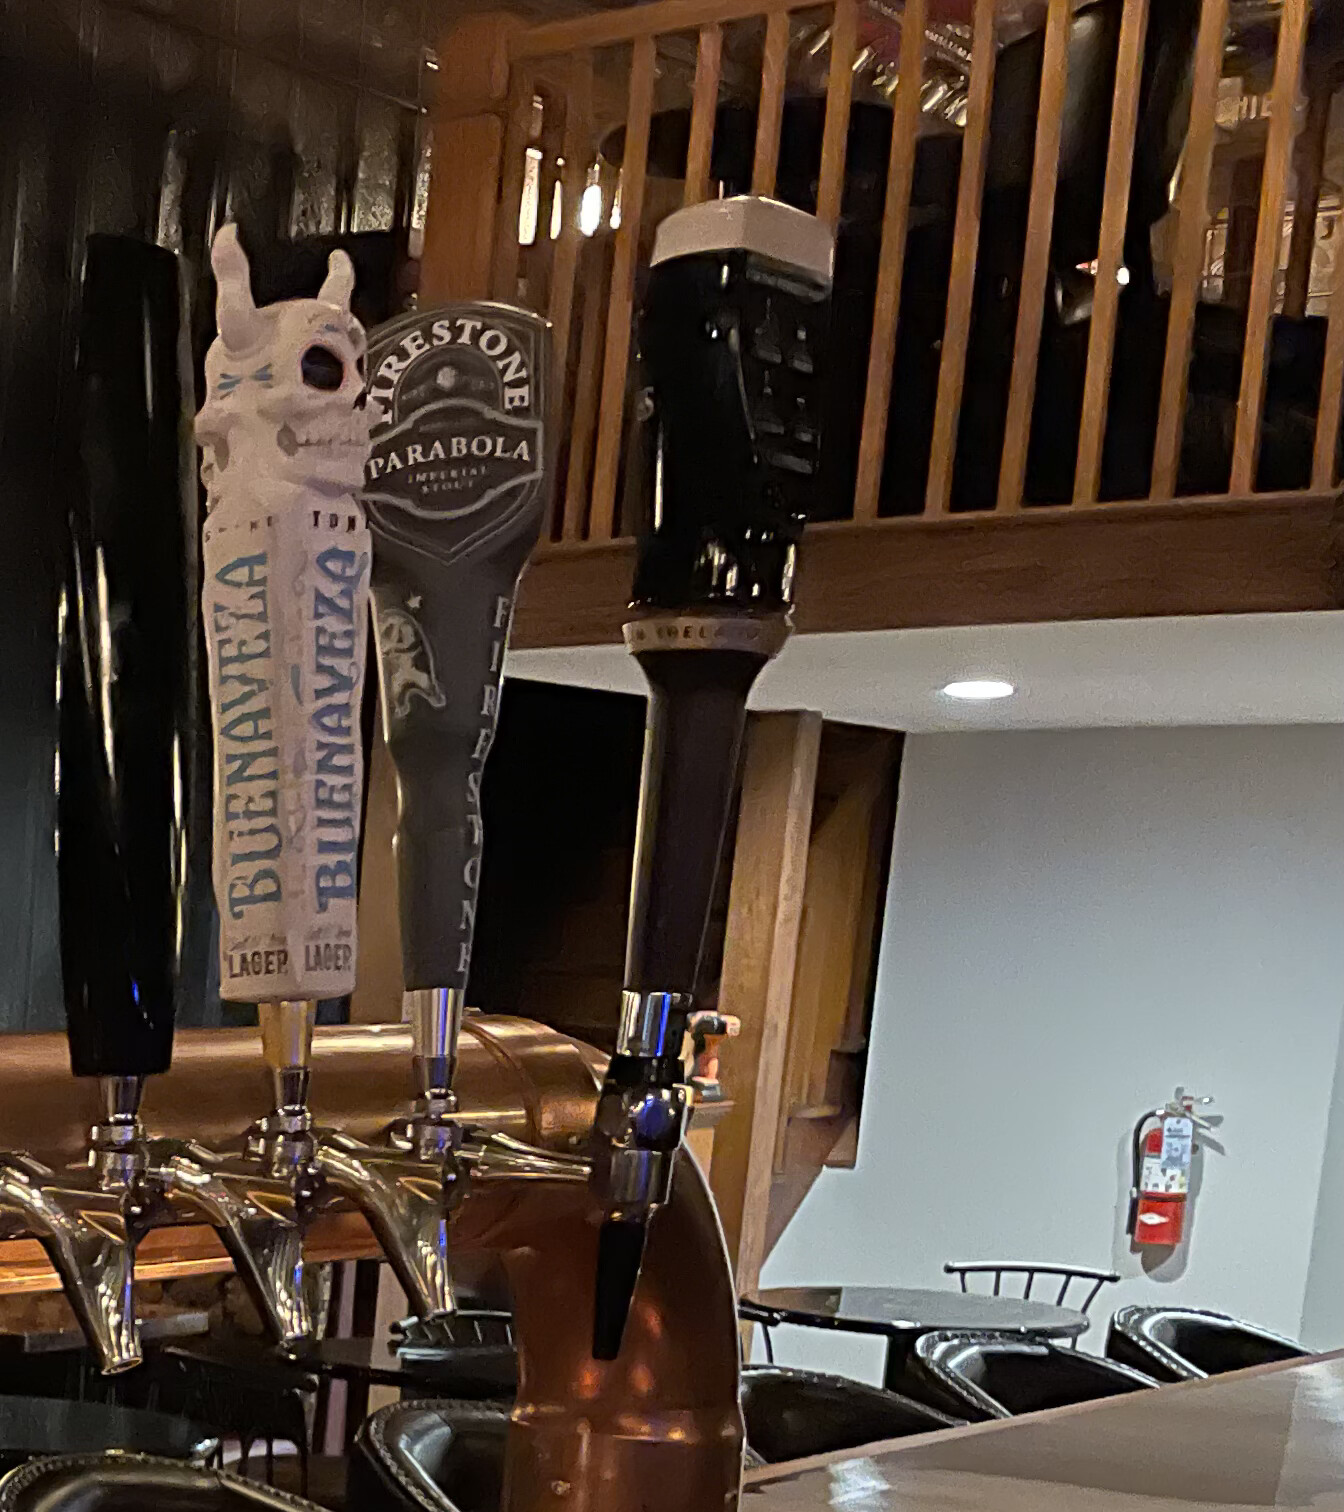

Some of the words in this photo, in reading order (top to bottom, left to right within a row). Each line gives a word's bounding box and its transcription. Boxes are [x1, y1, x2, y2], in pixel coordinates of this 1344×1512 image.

[367, 318, 530, 425] IRESTONE
[367, 435, 531, 480] PARABOLA
[315, 546, 366, 914] BUENAVEZA
[227, 948, 289, 979] LAGER
